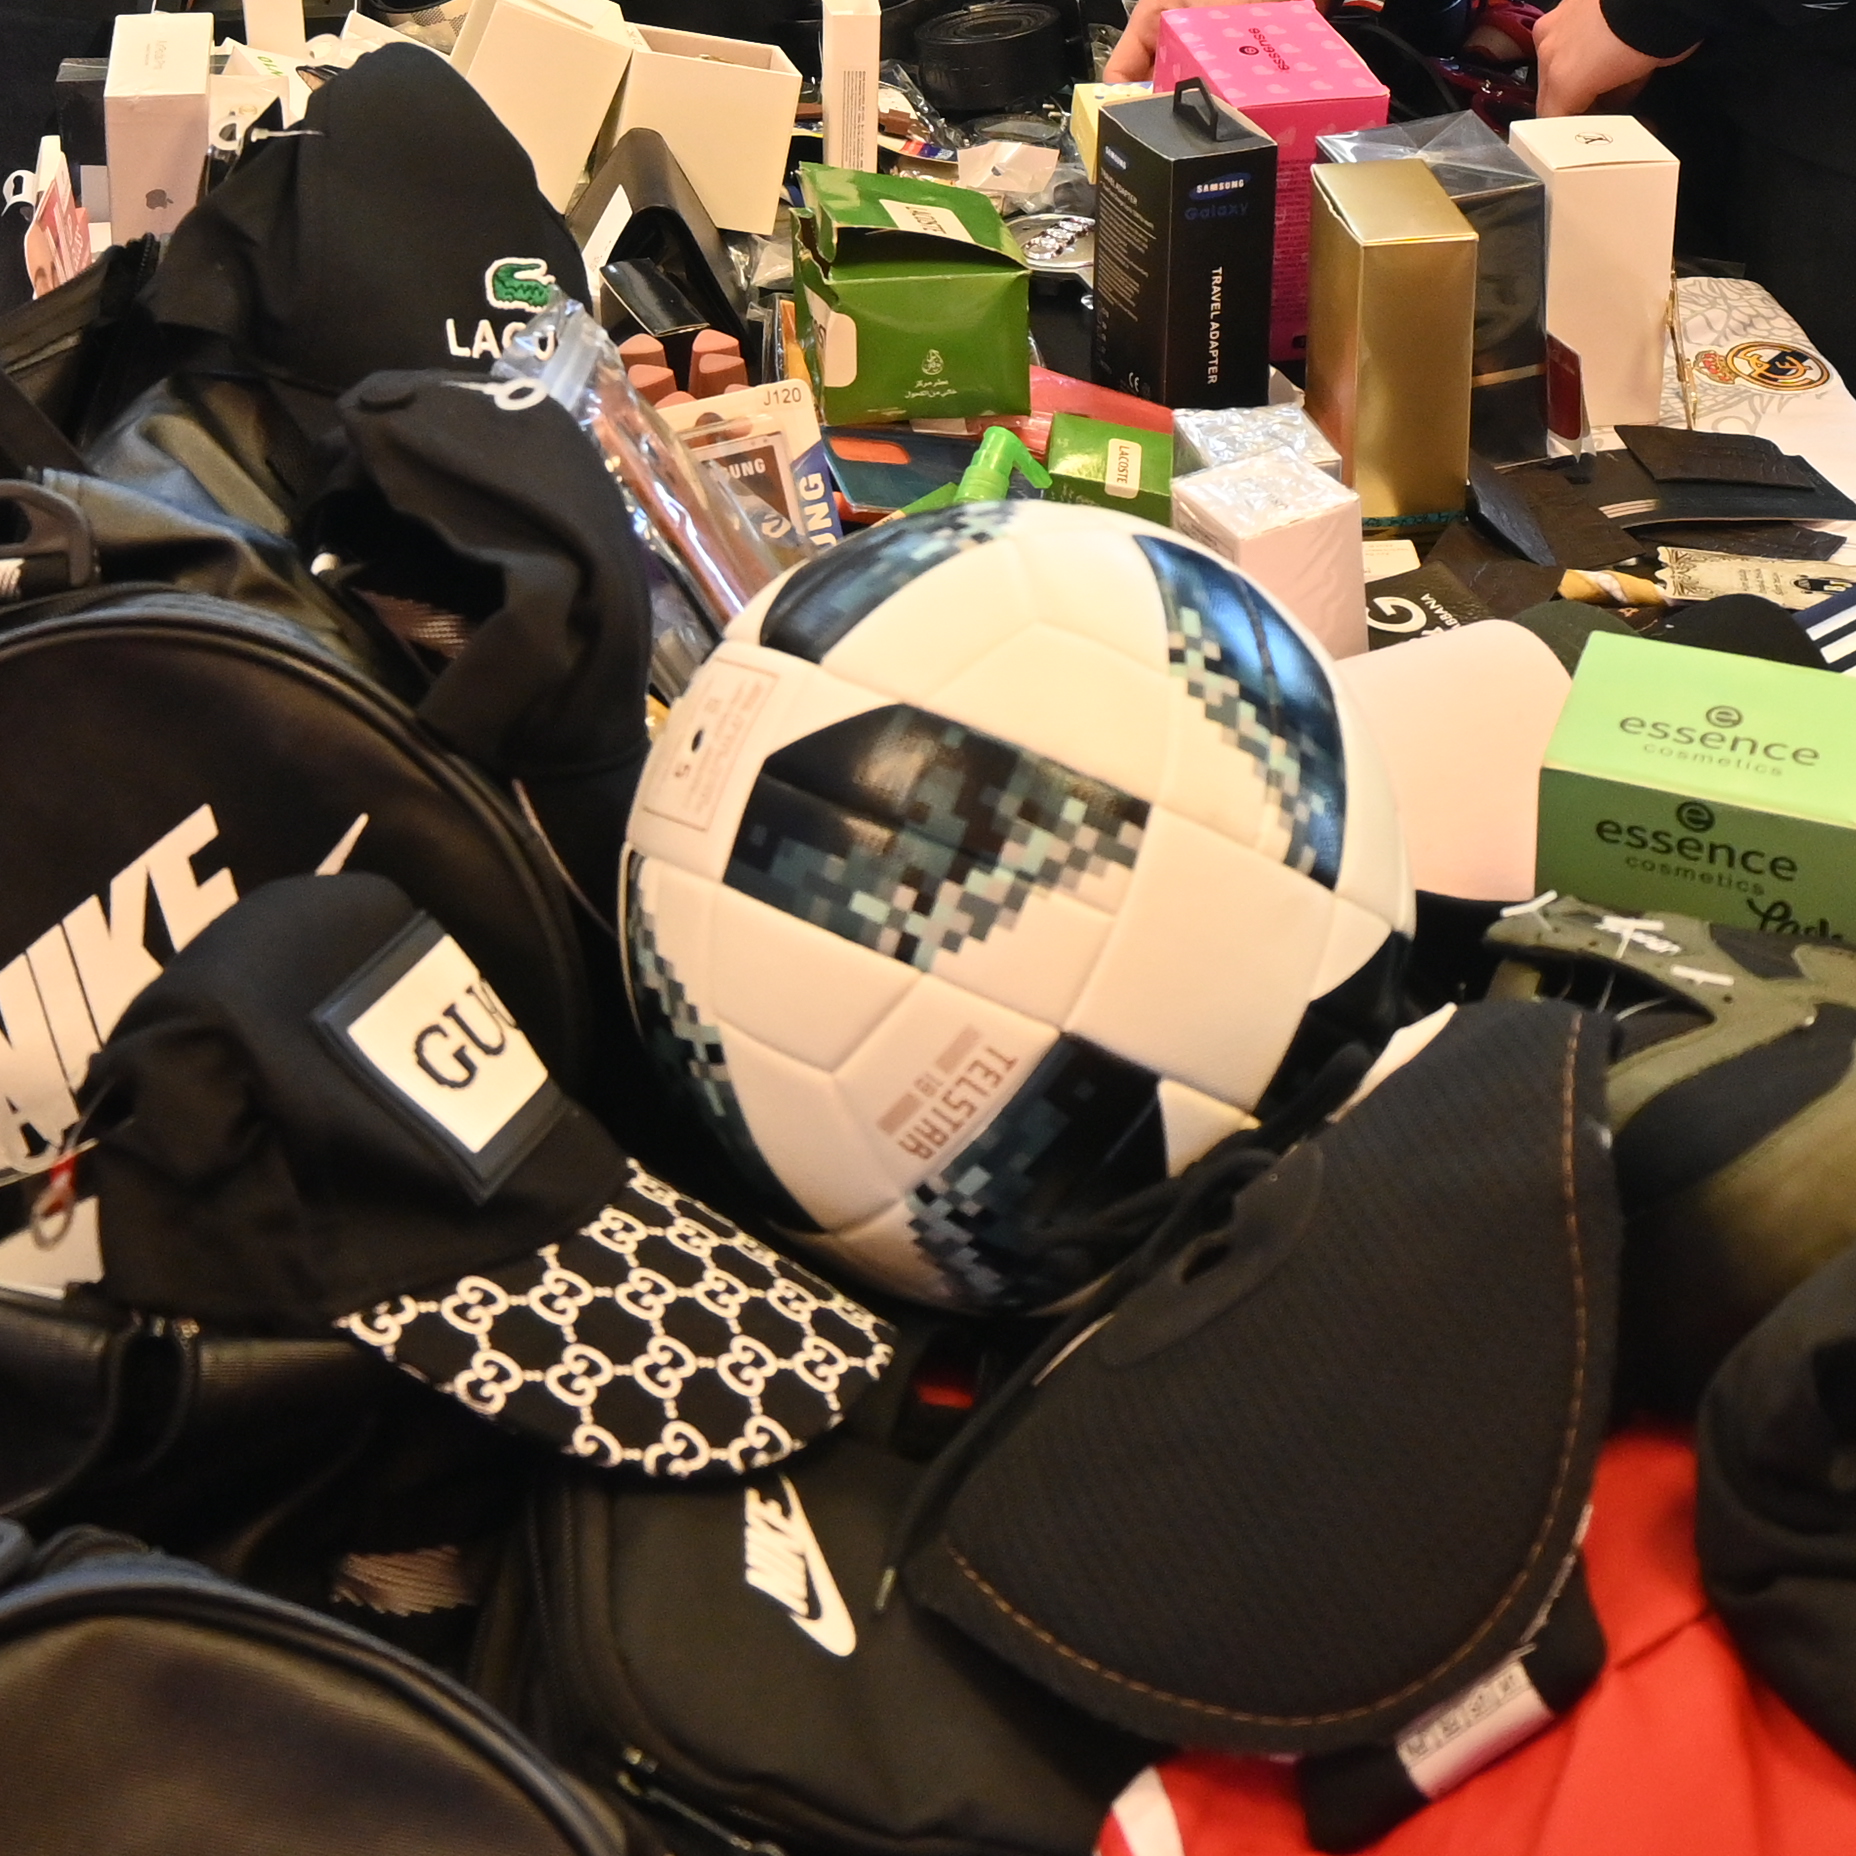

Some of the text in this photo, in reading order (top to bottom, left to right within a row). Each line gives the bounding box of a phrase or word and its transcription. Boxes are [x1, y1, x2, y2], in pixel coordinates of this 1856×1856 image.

[1247, 26, 1290, 72] essence
[1196, 178, 1244, 194] SAMSUNG
[1185, 201, 1249, 221] Galaxy
[1206, 265, 1223, 385] TRAVEL ADAPTER
[763, 386, 802, 406] J120
[1116, 444, 1131, 484] LACOSTE
[1619, 716, 1821, 767] essence
[1643, 743, 1784, 778] cosmetics
[1595, 818, 1799, 882] essence
[1624, 855, 1766, 896] cosmetics
[897, 1046, 1020, 1160] TELSTRA
[744, 1486, 812, 1617] NIKE
